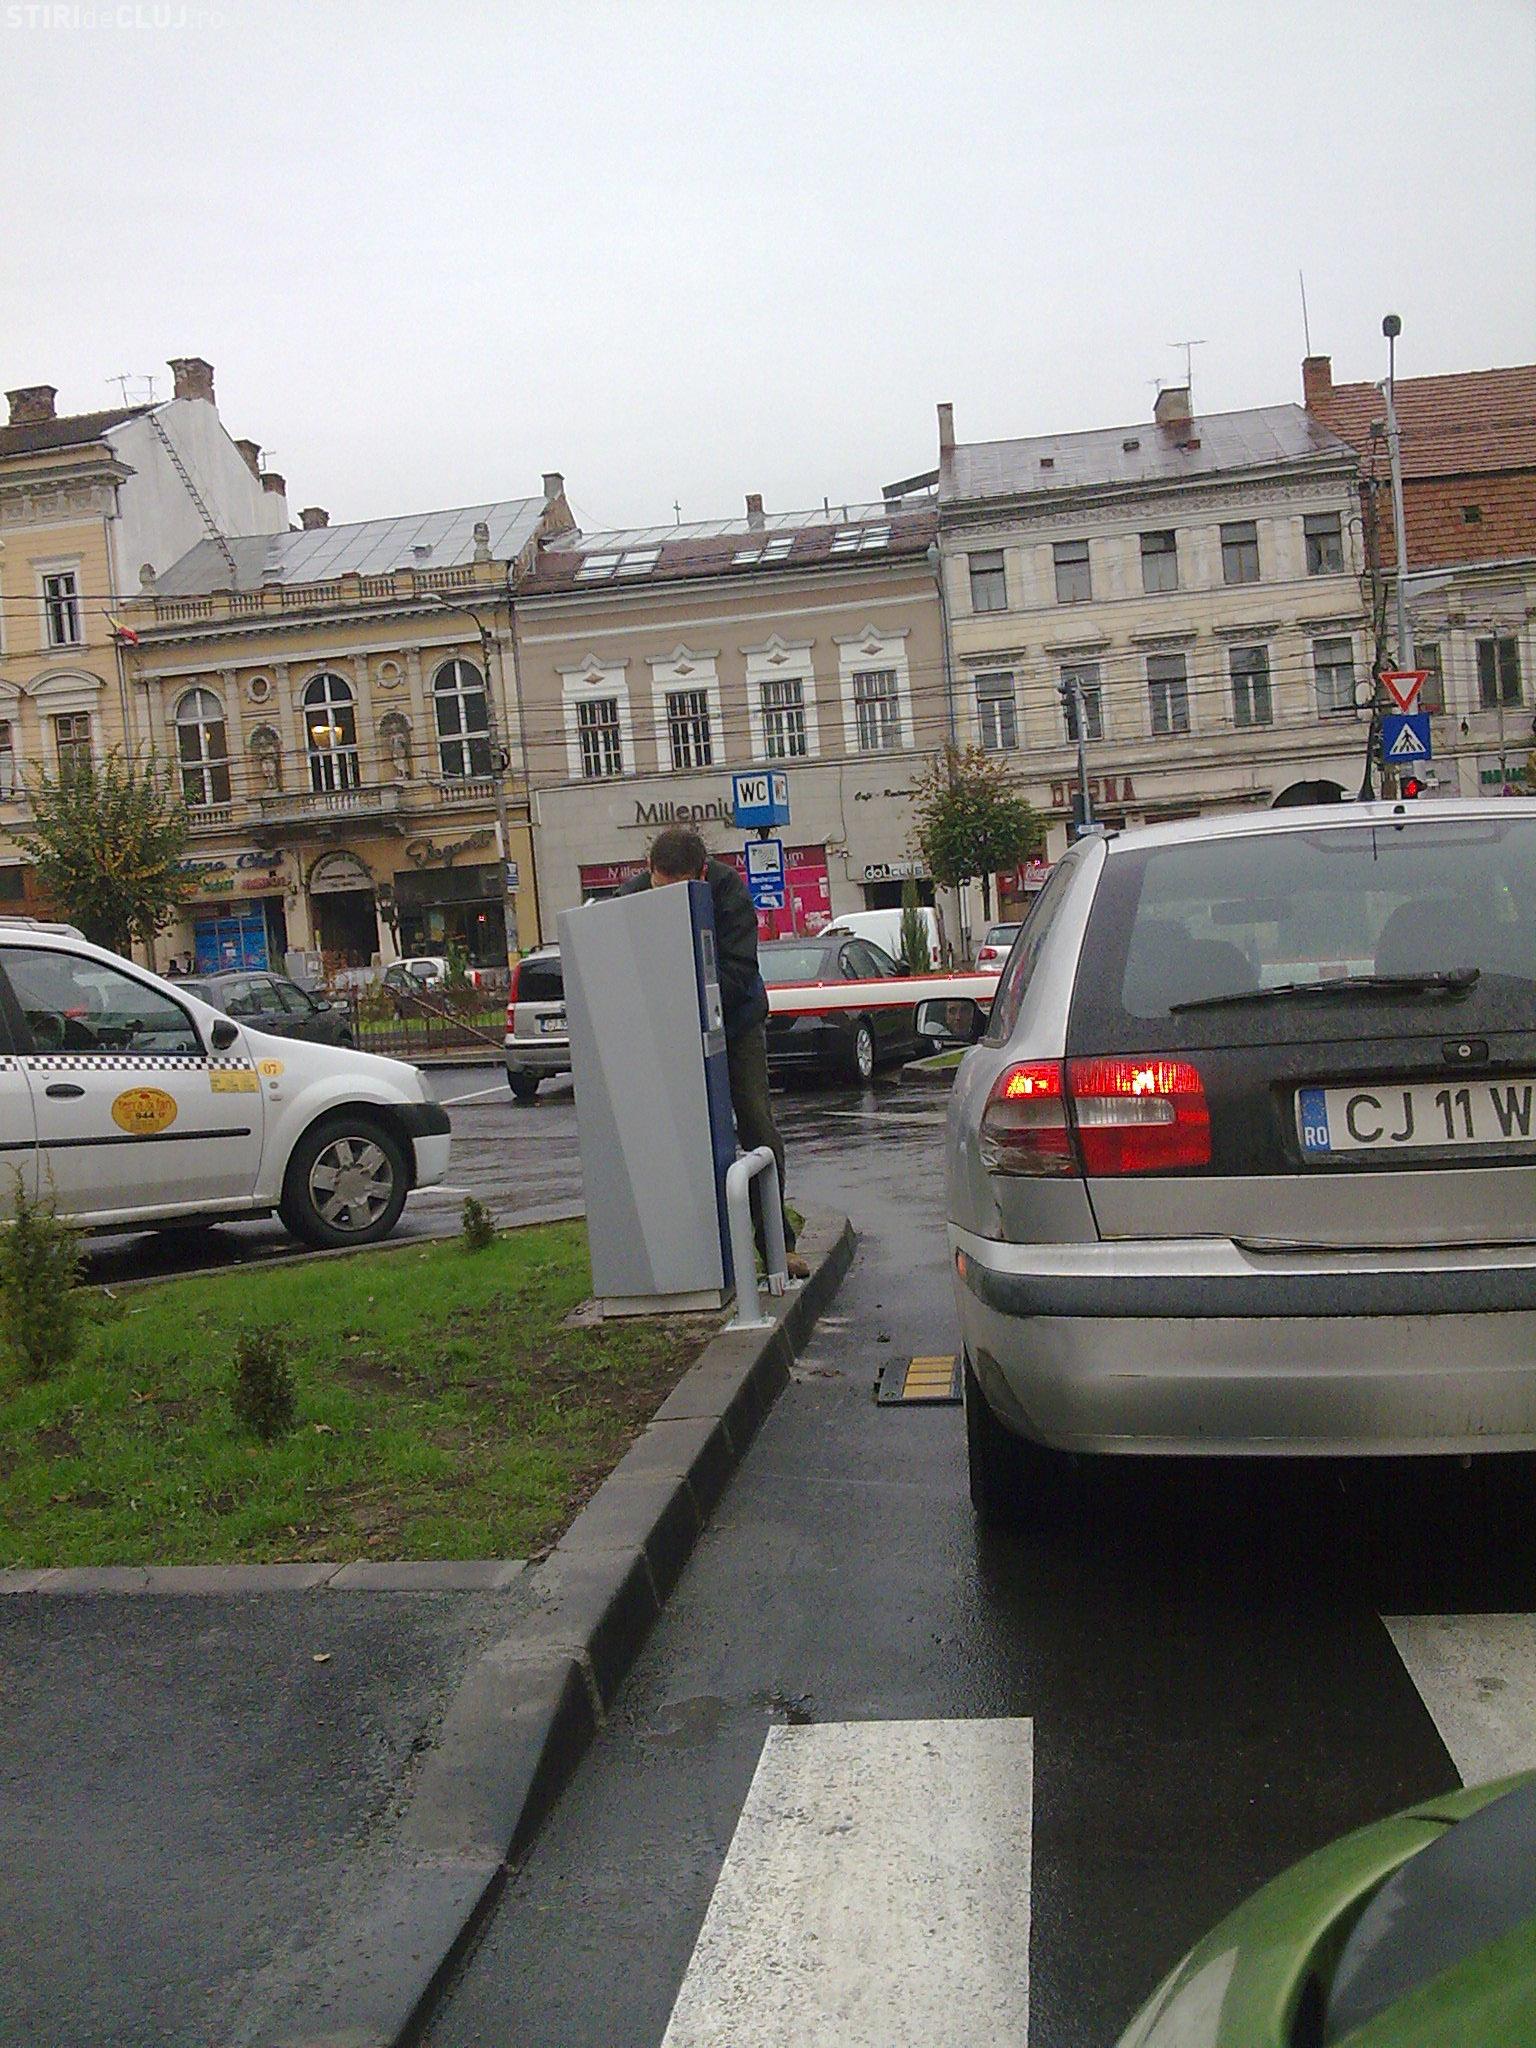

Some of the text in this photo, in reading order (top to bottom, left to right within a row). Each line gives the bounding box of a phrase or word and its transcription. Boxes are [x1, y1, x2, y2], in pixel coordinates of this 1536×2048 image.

[740, 781, 767, 802] WC
[635, 798, 735, 824] Millenniu
[263, 1063, 278, 1076] 07
[135, 1111, 155, 1120] 944
[1346, 1086, 1533, 1143] CJ 11 W
[1304, 1126, 1329, 1147] RO
